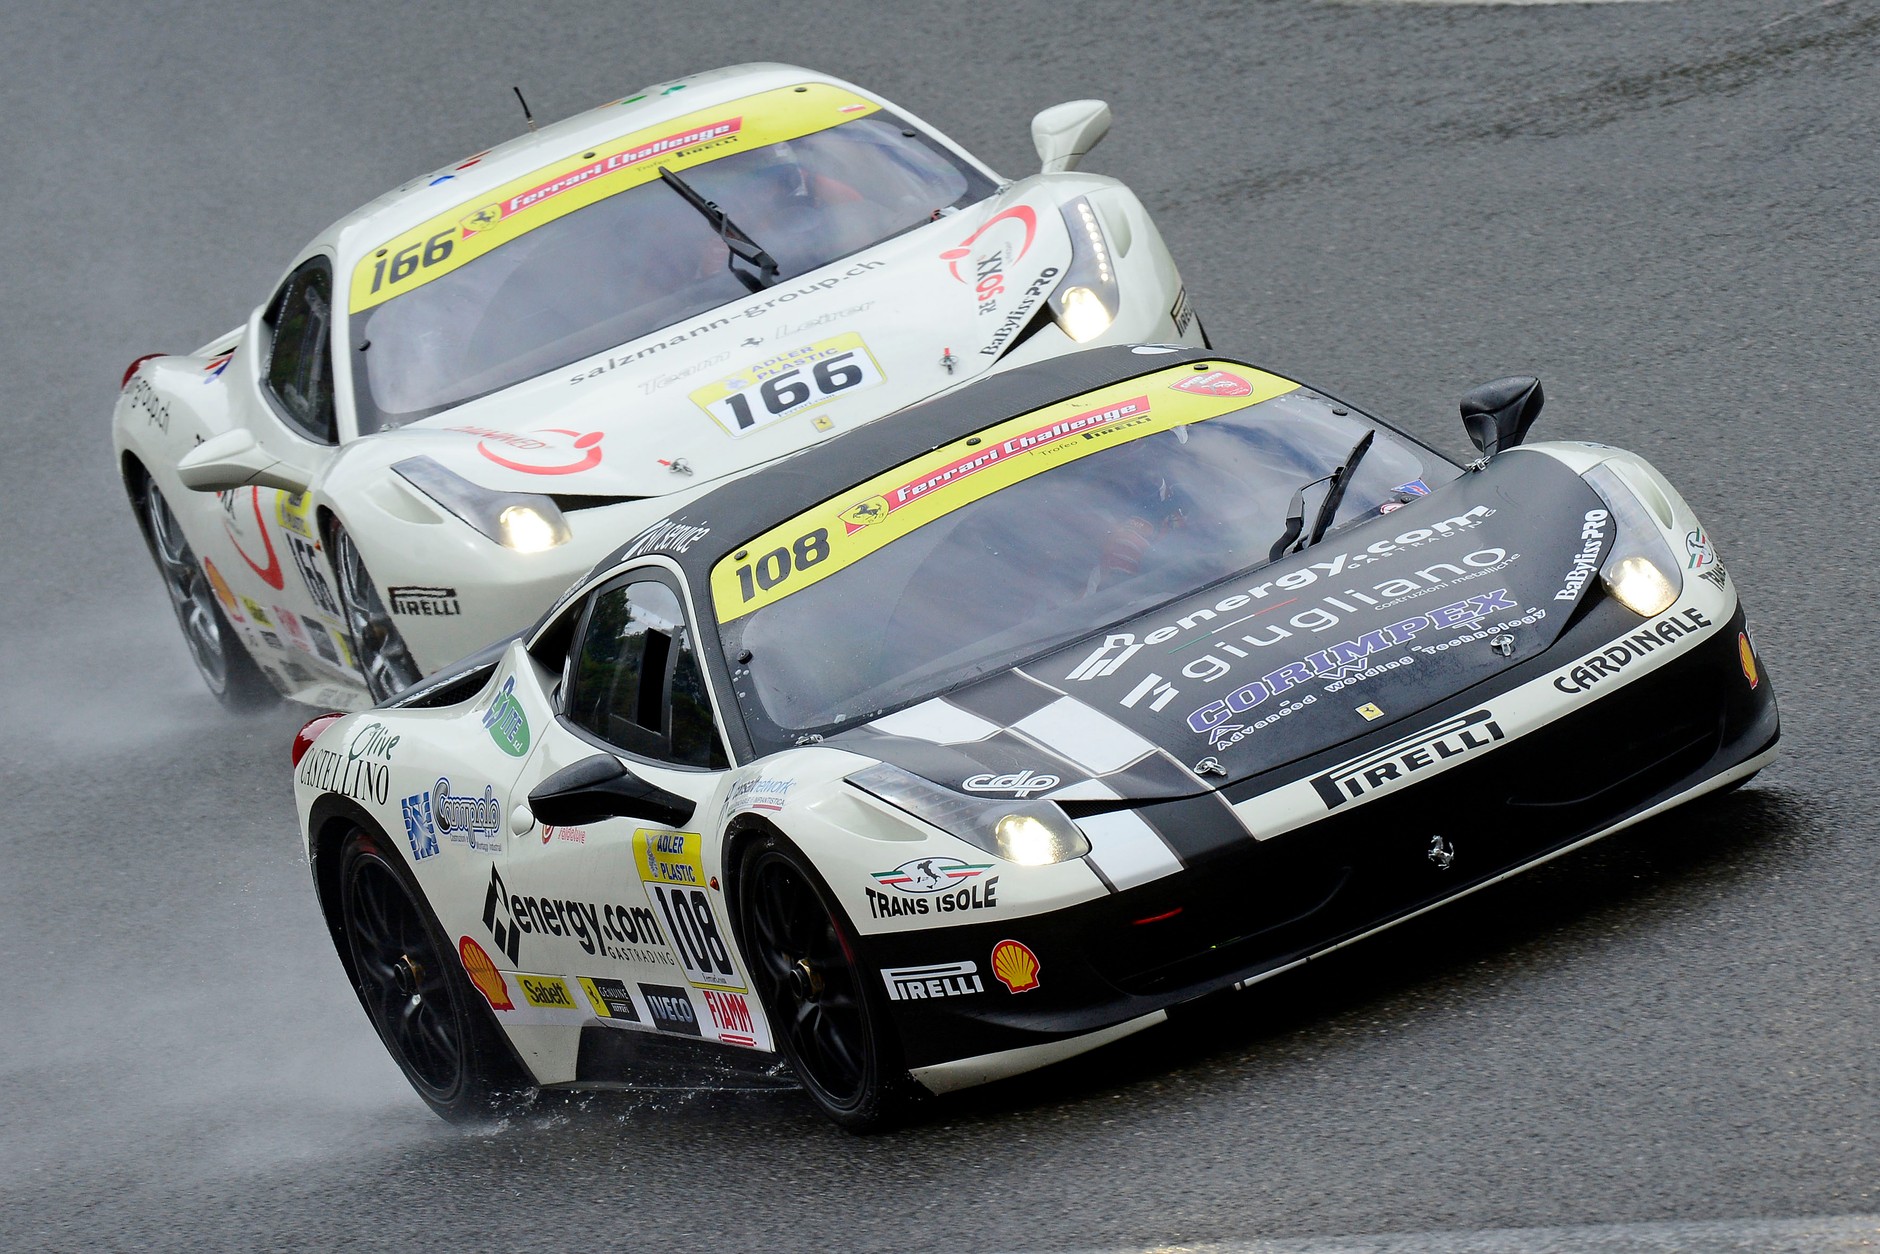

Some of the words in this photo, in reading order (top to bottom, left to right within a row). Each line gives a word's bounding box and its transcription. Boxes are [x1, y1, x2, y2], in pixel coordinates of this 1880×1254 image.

[509, 163, 602, 212] Ferrari
[607, 121, 732, 170] Challenge
[675, 135, 740, 159] PIRELLI
[369, 227, 456, 295] 166
[569, 257, 886, 386] salzmann-group.ch
[751, 345, 814, 373] ADLER
[756, 347, 839, 380] PLASTIC
[724, 351, 863, 430] 166
[895, 448, 999, 503] Ferrari
[1002, 402, 1137, 455] Challenge
[1037, 440, 1079, 457] Trofeo
[1081, 414, 1153, 441] PIRELLI
[1347, 508, 1497, 570] GASTRADING
[735, 527, 831, 604] 108
[1374, 582, 1449, 611] costruzioni
[1452, 552, 1521, 585] metalliche
[387, 586, 460, 616] PIRELLI
[1181, 546, 1507, 684] giugliano
[1186, 587, 1518, 734] CORIMPEX
[1552, 606, 1712, 694] CARDINALE
[1217, 694, 1318, 752] Advanced
[1323, 655, 1415, 693] Welding
[1420, 608, 1547, 656] Technology
[348, 722, 401, 761] Olive
[1309, 708, 1505, 811] PIRELLI
[300, 747, 390, 806] CASTELLINO
[962, 769, 1061, 798] cdp
[656, 834, 685, 855] ADLER
[660, 862, 696, 883] PLASTIC
[865, 886, 930, 920] TRANS
[936, 875, 999, 914] ISOLE
[654, 886, 734, 976] 108
[607, 946, 676, 967] GASTRADING
[523, 979, 571, 1006] Sabelt
[598, 985, 630, 1001] GENUINE
[880, 960, 985, 1001] PIRELLI
[647, 995, 694, 1024] IVECO
[703, 990, 755, 1034] FIAMM
